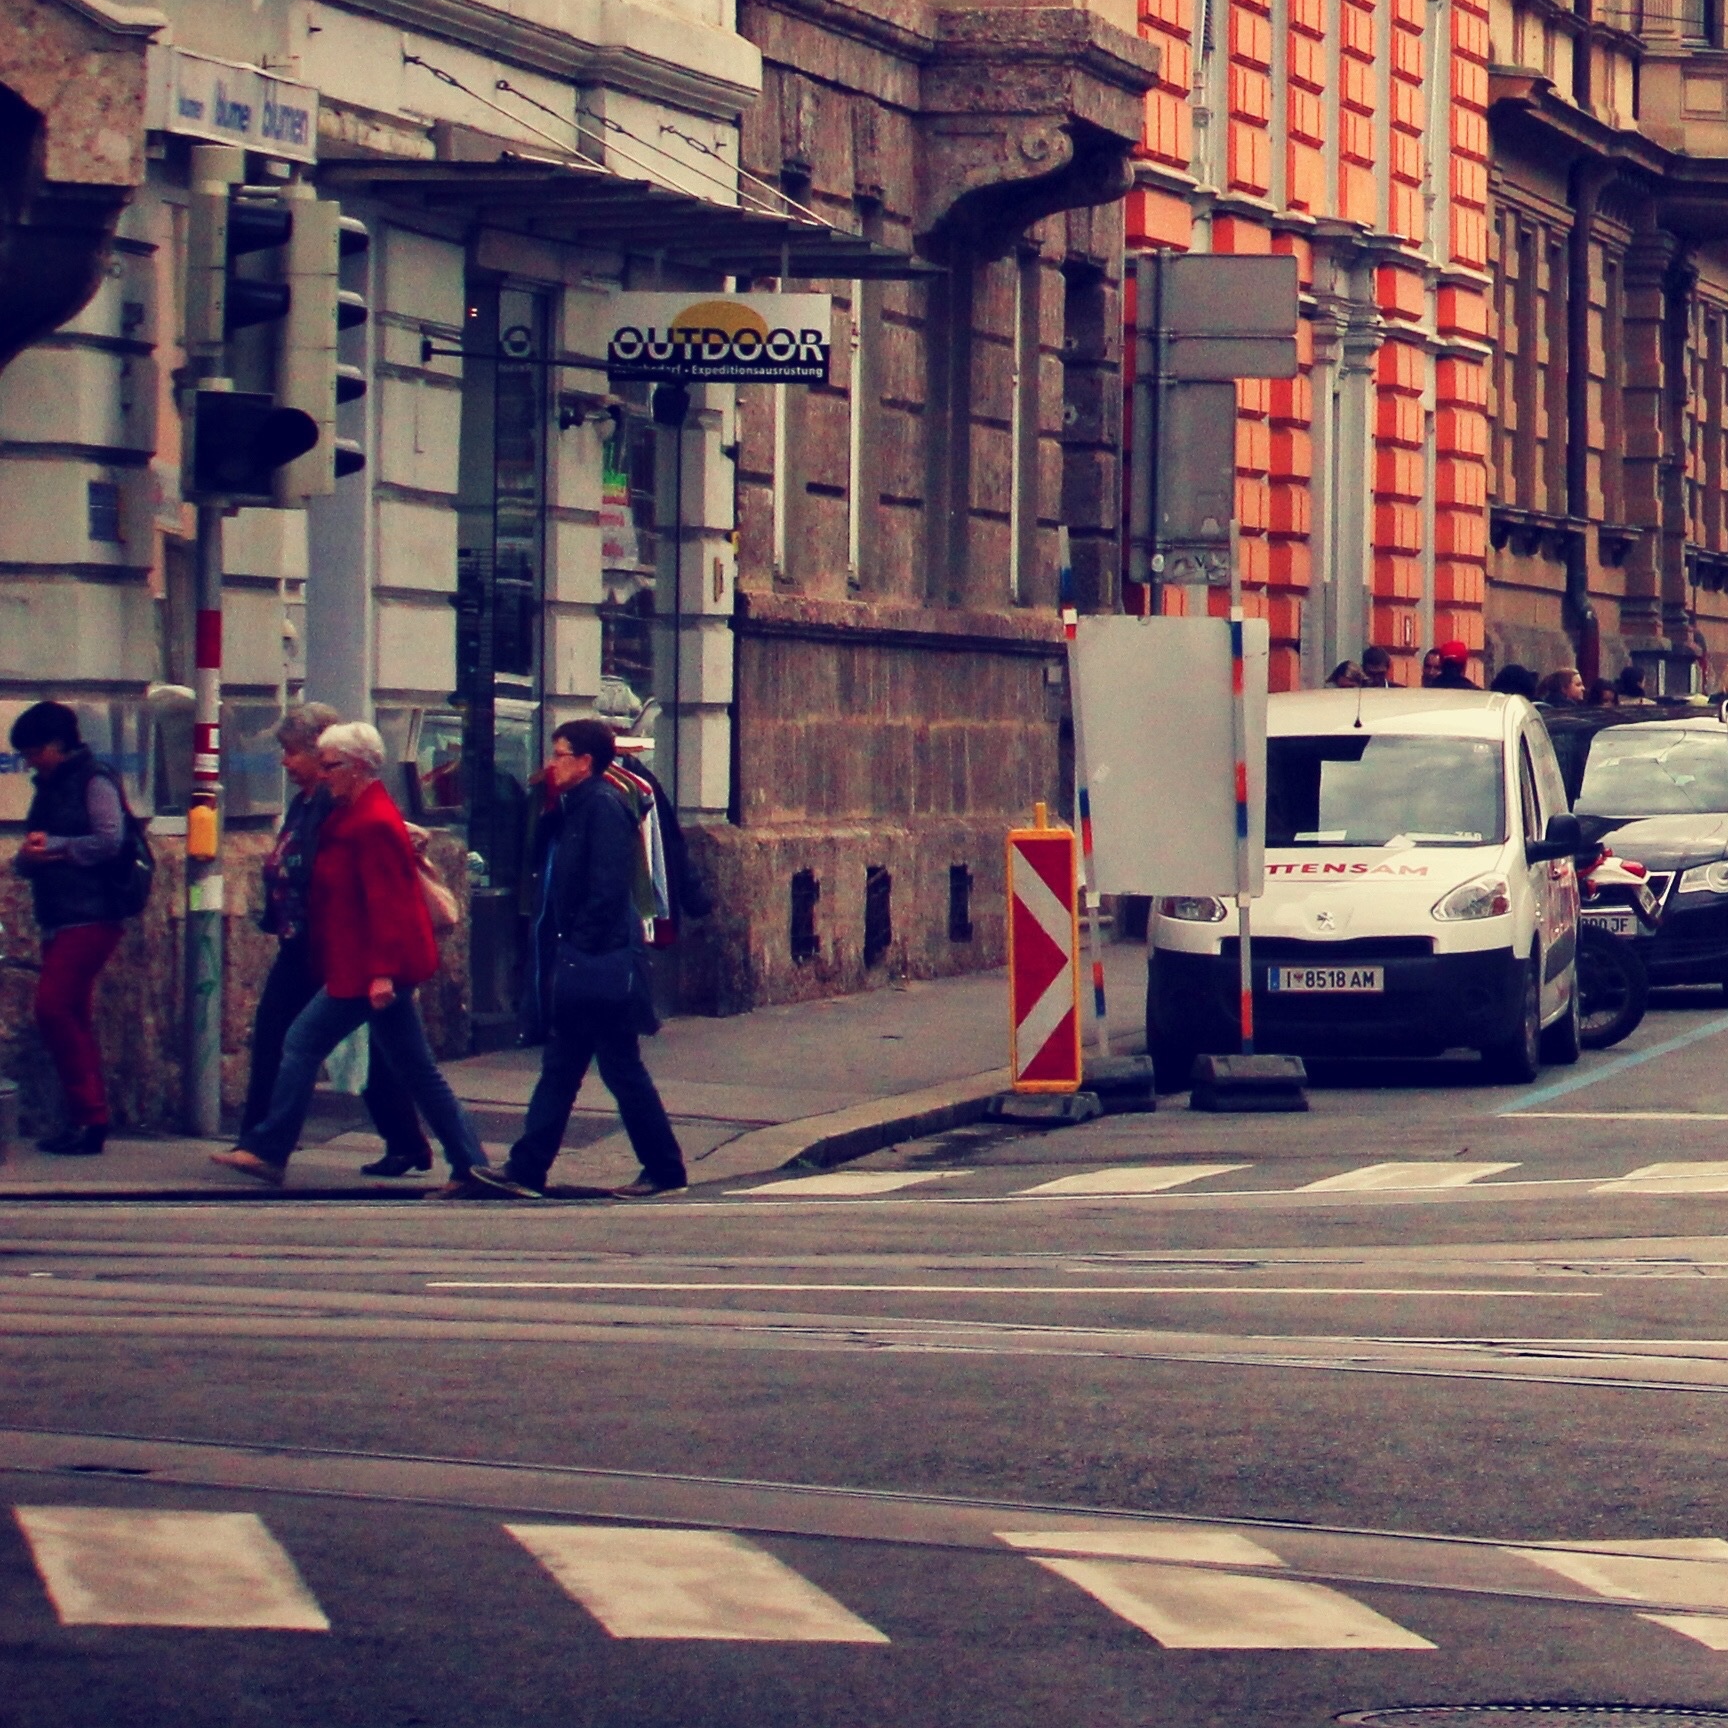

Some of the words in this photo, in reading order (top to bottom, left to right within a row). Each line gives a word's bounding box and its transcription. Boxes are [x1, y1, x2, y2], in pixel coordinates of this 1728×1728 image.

[262, 76, 309, 146] blumen
[613, 326, 824, 362] OUTDOOR
[1611, 917, 1629, 932] JF
[1305, 970, 1346, 989] 8518
[1350, 971, 1375, 988] AM
